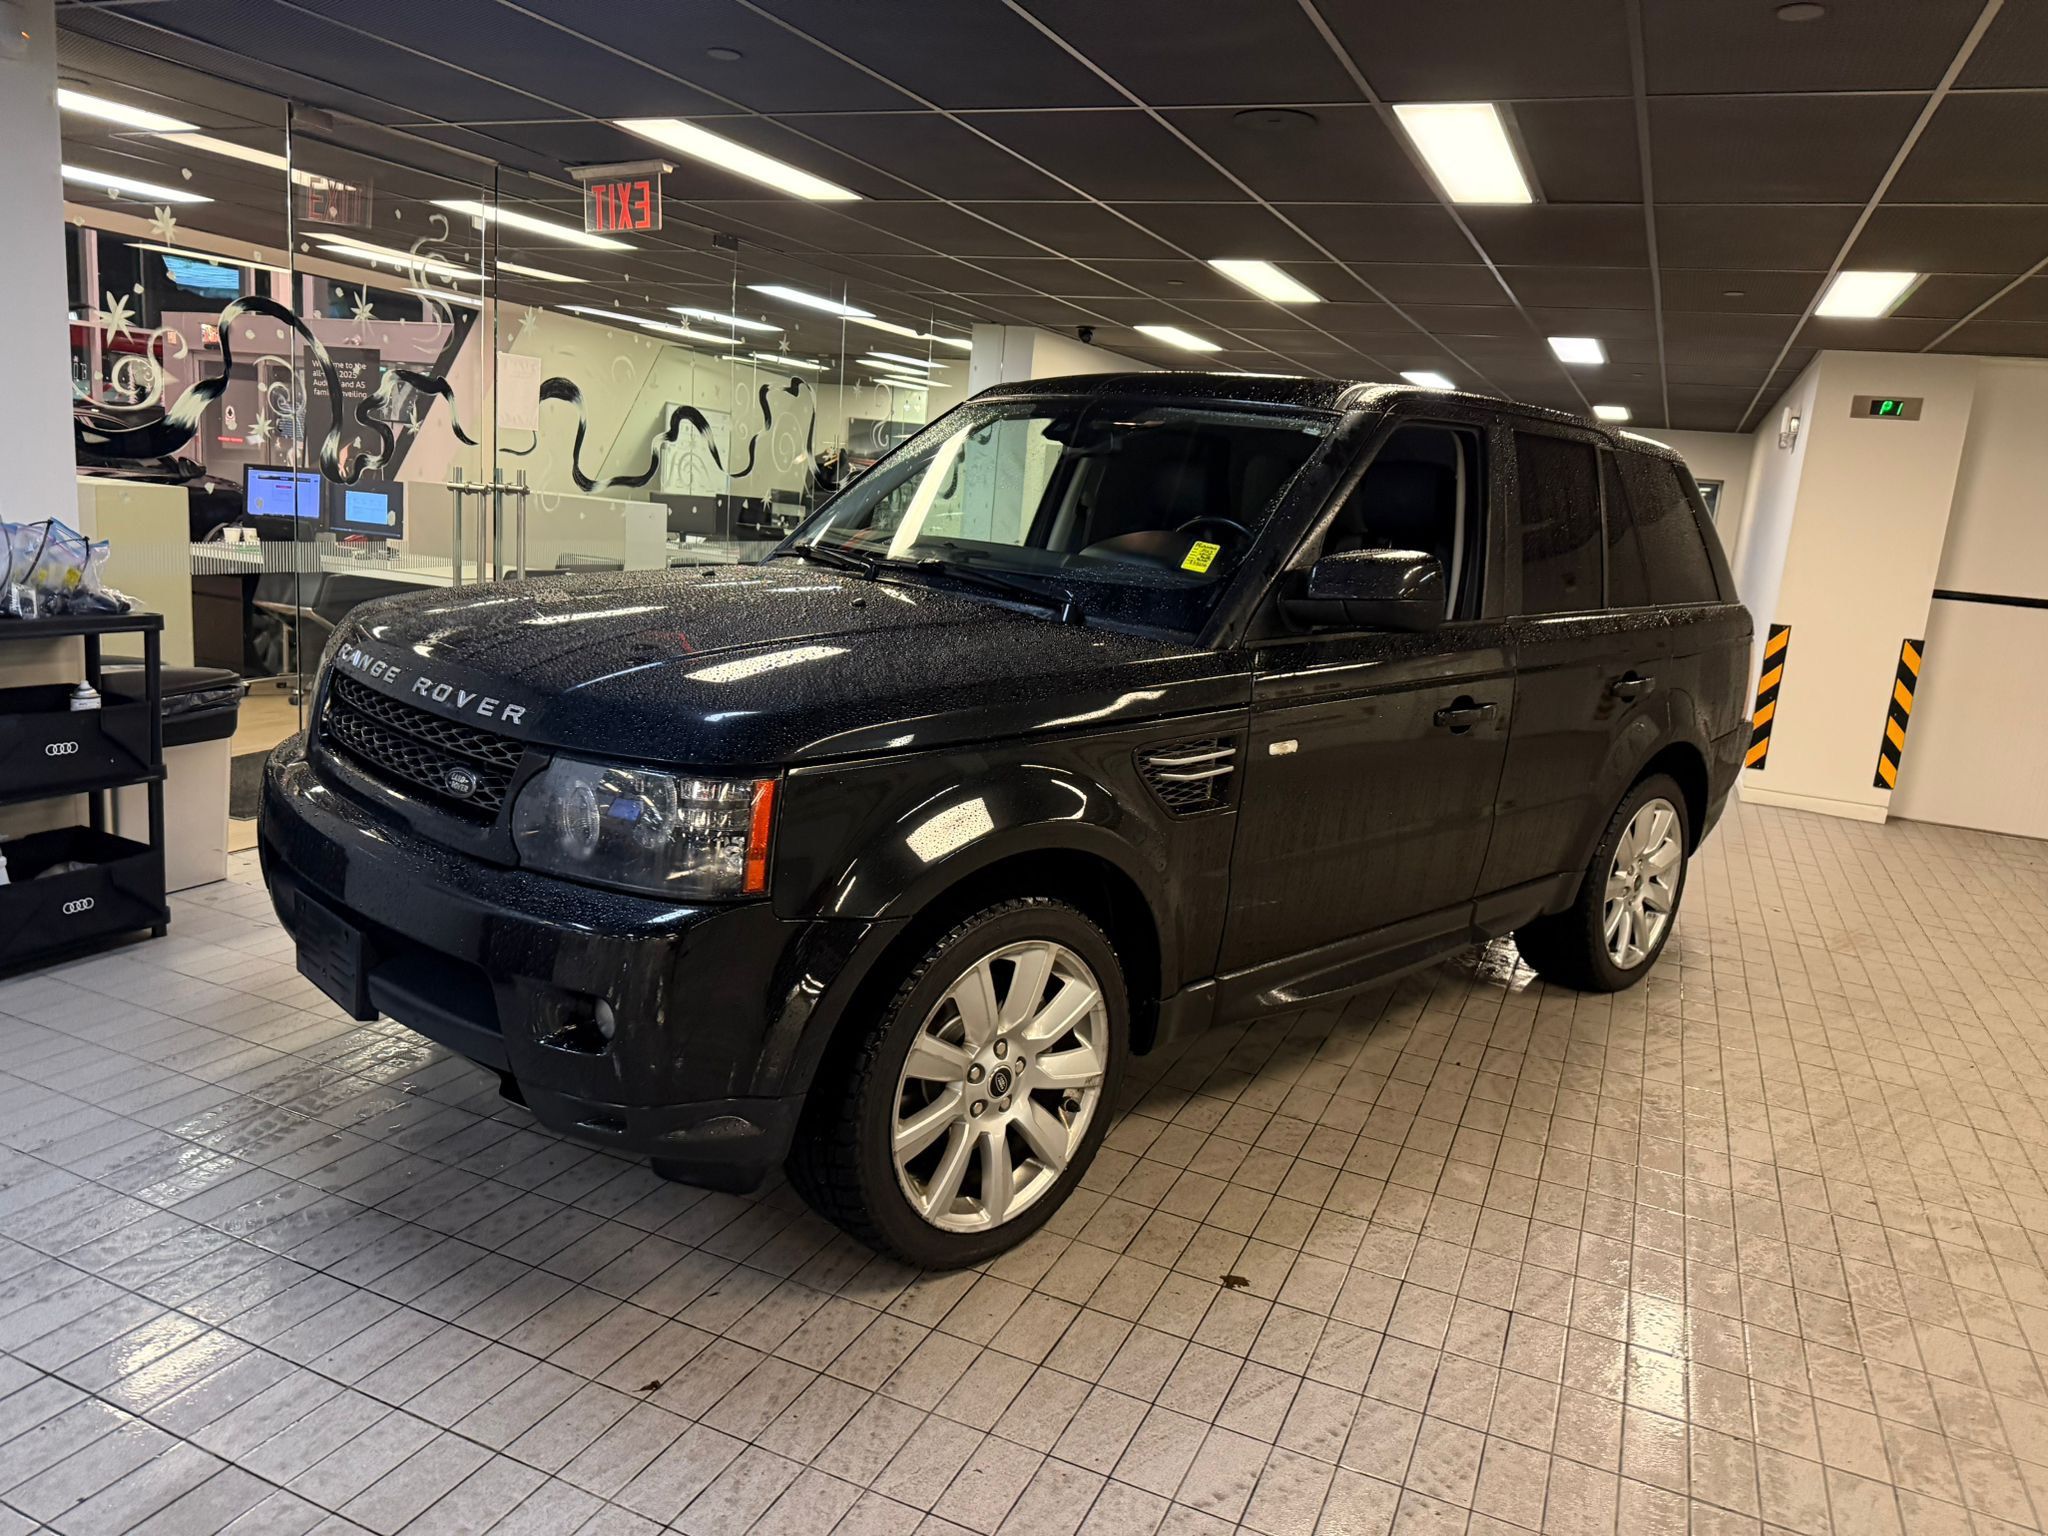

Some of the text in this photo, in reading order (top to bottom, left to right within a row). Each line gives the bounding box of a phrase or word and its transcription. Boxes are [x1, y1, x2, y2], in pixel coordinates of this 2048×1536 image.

[339, 371, 358, 379] 2025
[1879, 400, 1904, 416] P1
[337, 643, 526, 725] RANGE ROVER
